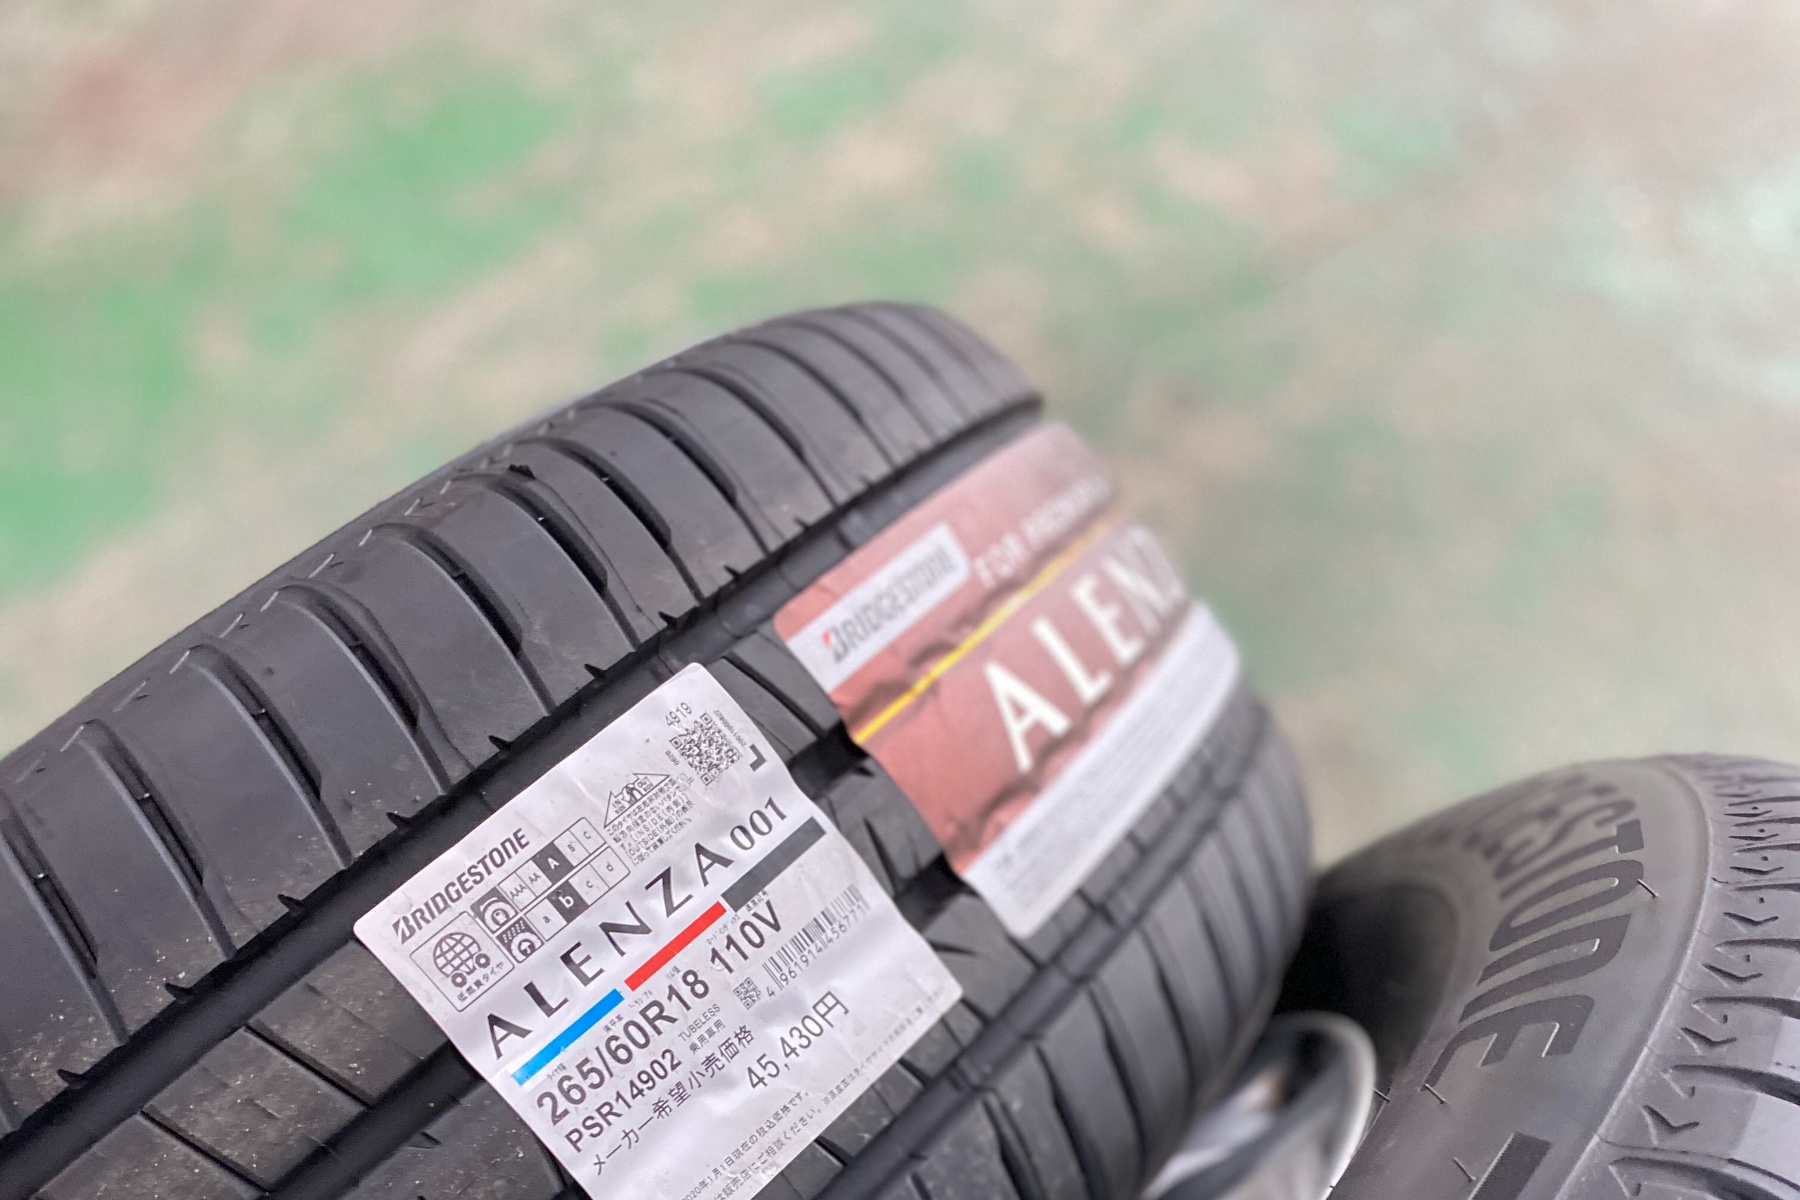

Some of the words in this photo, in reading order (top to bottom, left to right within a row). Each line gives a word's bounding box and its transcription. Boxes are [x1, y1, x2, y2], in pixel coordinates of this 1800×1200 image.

[663, 700, 693, 728] 4919
[392, 827, 530, 944] BRIDGESTONE
[484, 840, 735, 1060] ALENZA
[727, 796, 788, 854] 001
[508, 882, 527, 899] AAA
[527, 871, 541, 885] AA
[546, 855, 560, 870] A
[540, 913, 551, 924] a
[558, 890, 576, 909] b
[604, 861, 614, 872] d
[533, 965, 712, 1126] 265/60R18
[704, 899, 784, 979] 110V
[687, 1018, 727, 1055] 乗用車用
[745, 990, 850, 1091] 45,430円
[563, 1047, 683, 1154] PSR14902
[677, 1002, 722, 1043] TUBELESS
[588, 1022, 757, 1175] メーカー希望小売価格
